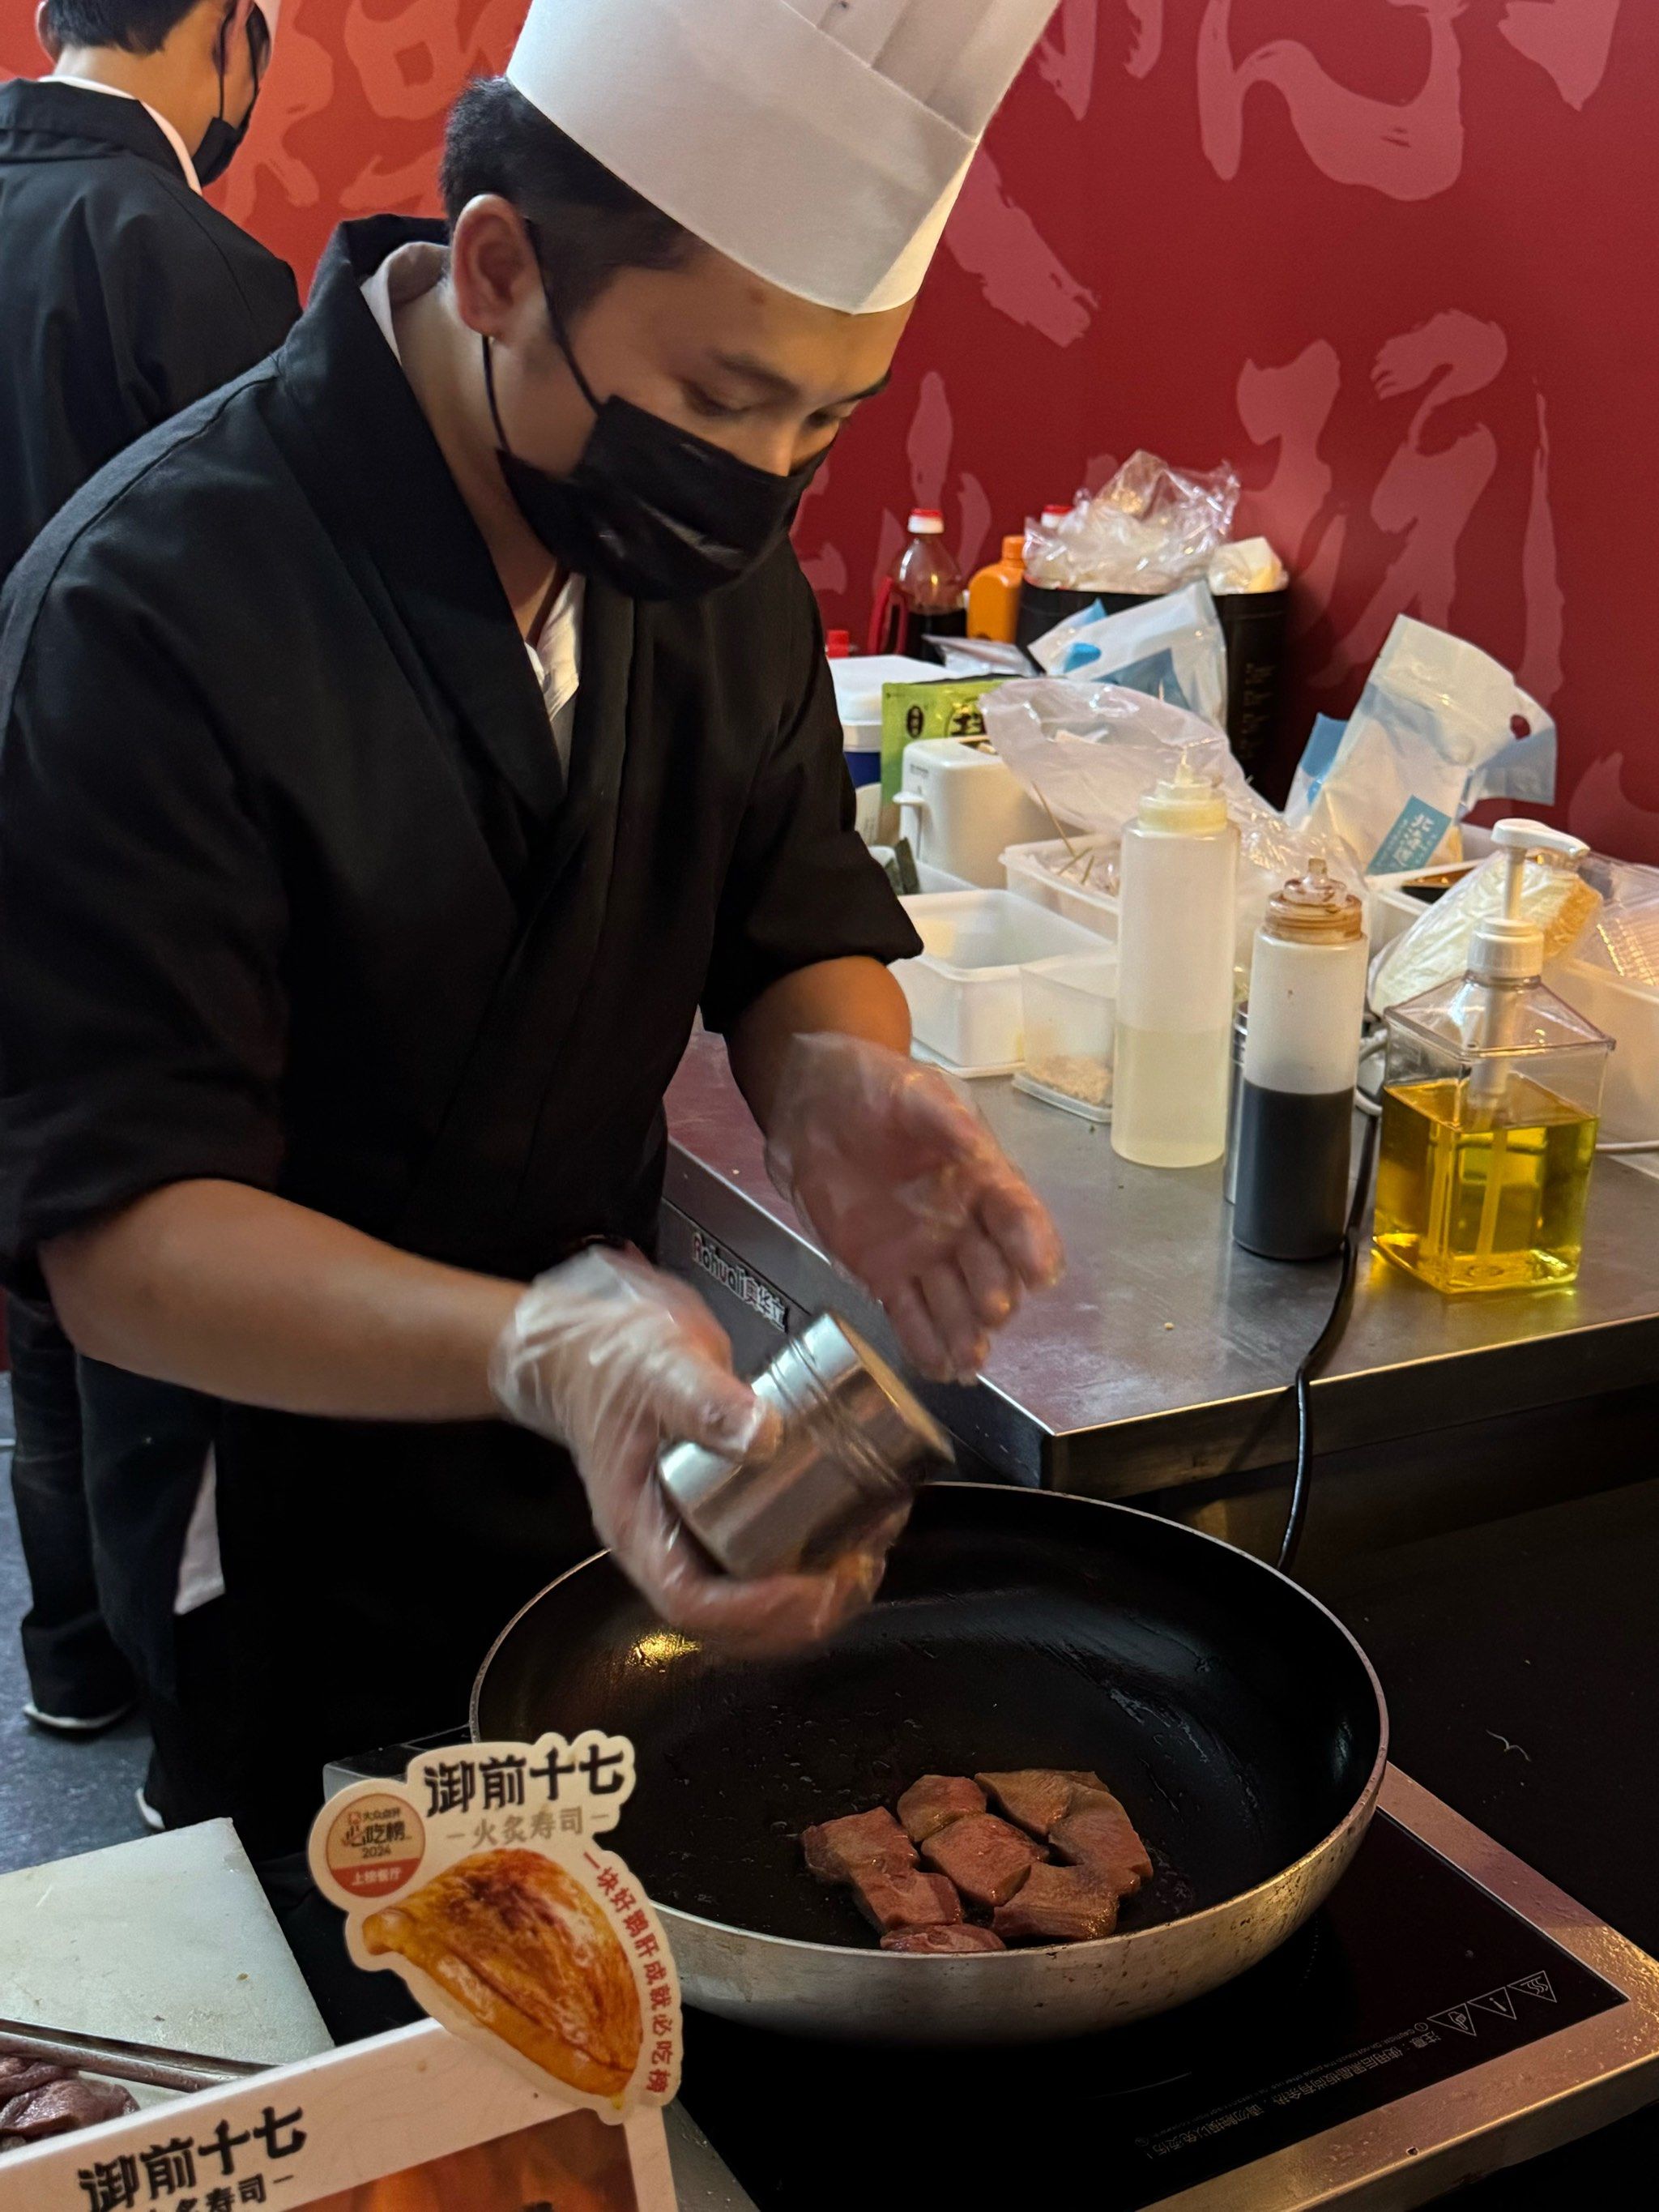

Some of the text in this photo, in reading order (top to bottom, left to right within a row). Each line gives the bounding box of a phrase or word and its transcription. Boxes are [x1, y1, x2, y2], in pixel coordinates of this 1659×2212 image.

[423, 1744, 625, 1817] 御前十七
[362, 1844, 392, 1859] 2024
[472, 1805, 583, 1849] 火炙寿司
[78, 2106, 307, 2212] 御前十七
